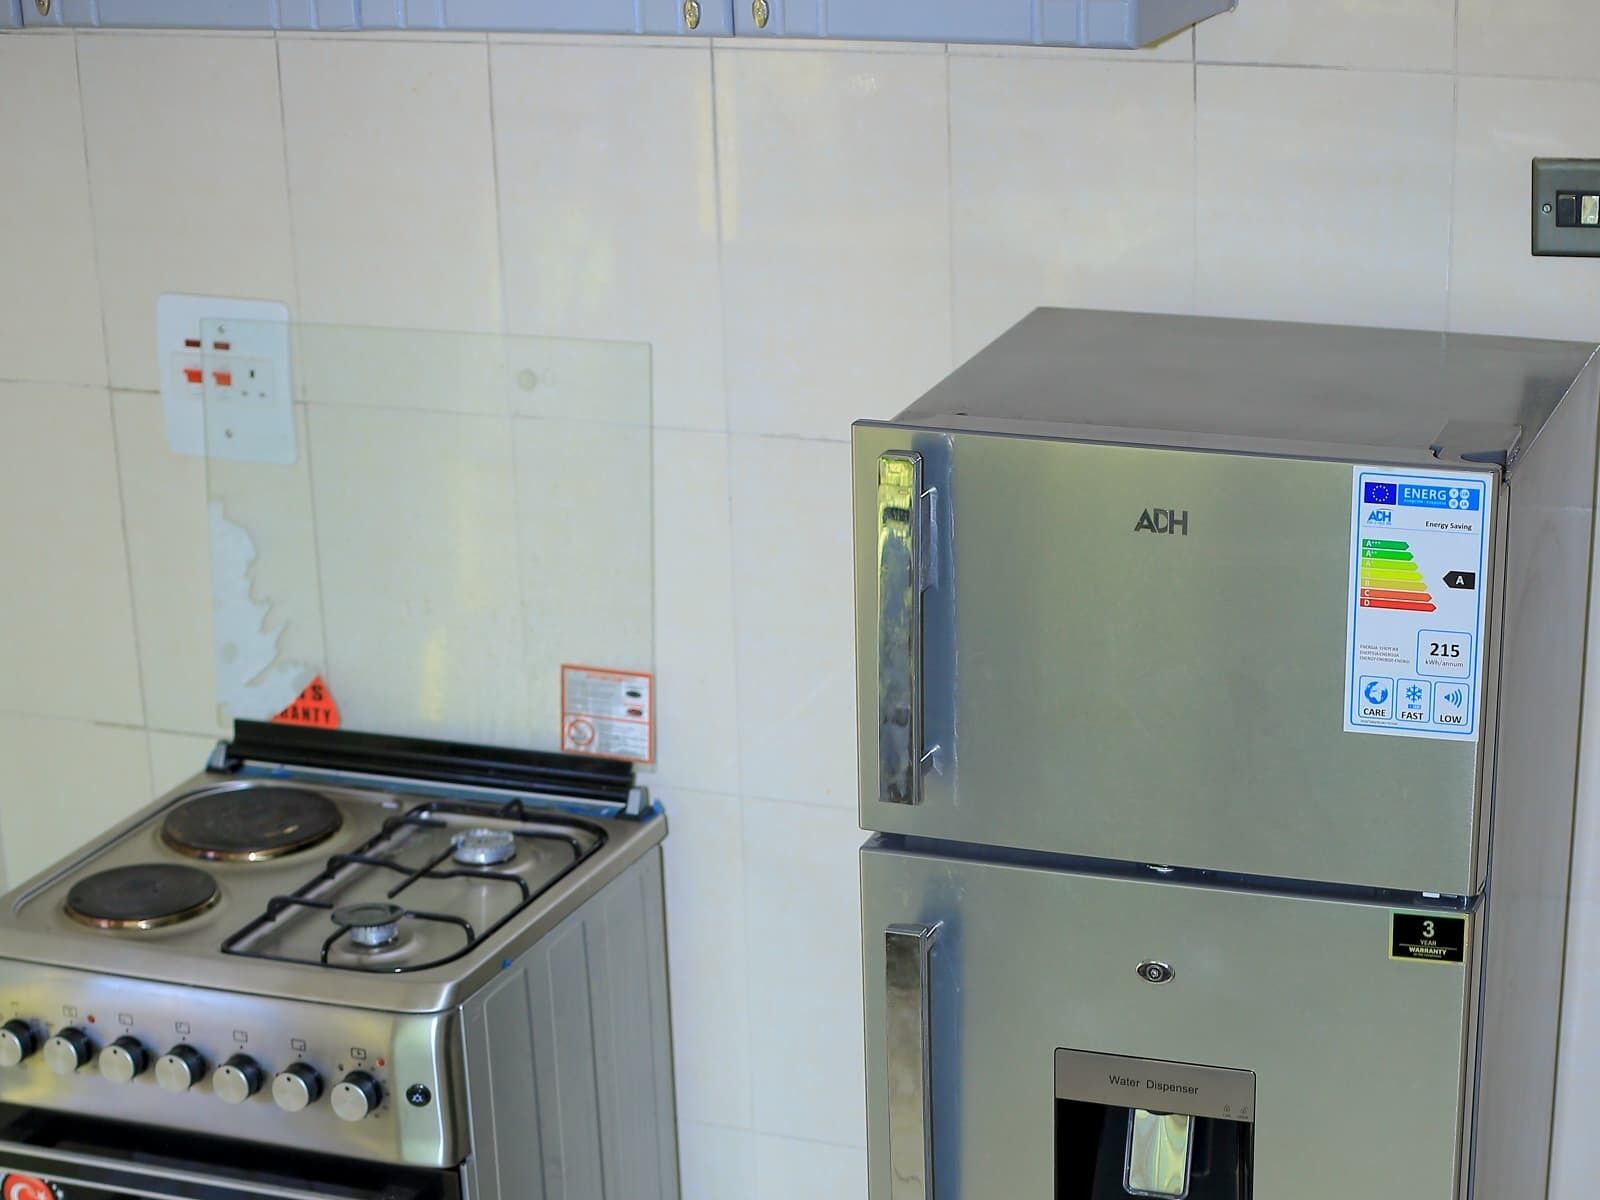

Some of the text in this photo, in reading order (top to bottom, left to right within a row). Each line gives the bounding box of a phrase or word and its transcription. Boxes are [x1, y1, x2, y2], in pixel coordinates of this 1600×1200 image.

[1403, 487, 1447, 501] ENERG
[1134, 507, 1188, 536] ADH
[1367, 509, 1392, 523] ADH
[1425, 520, 1473, 531] Energy Saving
[1455, 575, 1465, 585] A
[1430, 642, 1460, 658] 215
[1363, 707, 1386, 717] CARE
[1401, 711, 1424, 720] FAST
[1439, 714, 1462, 724] LOW
[1422, 920, 1435, 938] 3
[1408, 946, 1447, 956] WARRANTY
[1109, 1075, 1199, 1095] Water Dispenser
